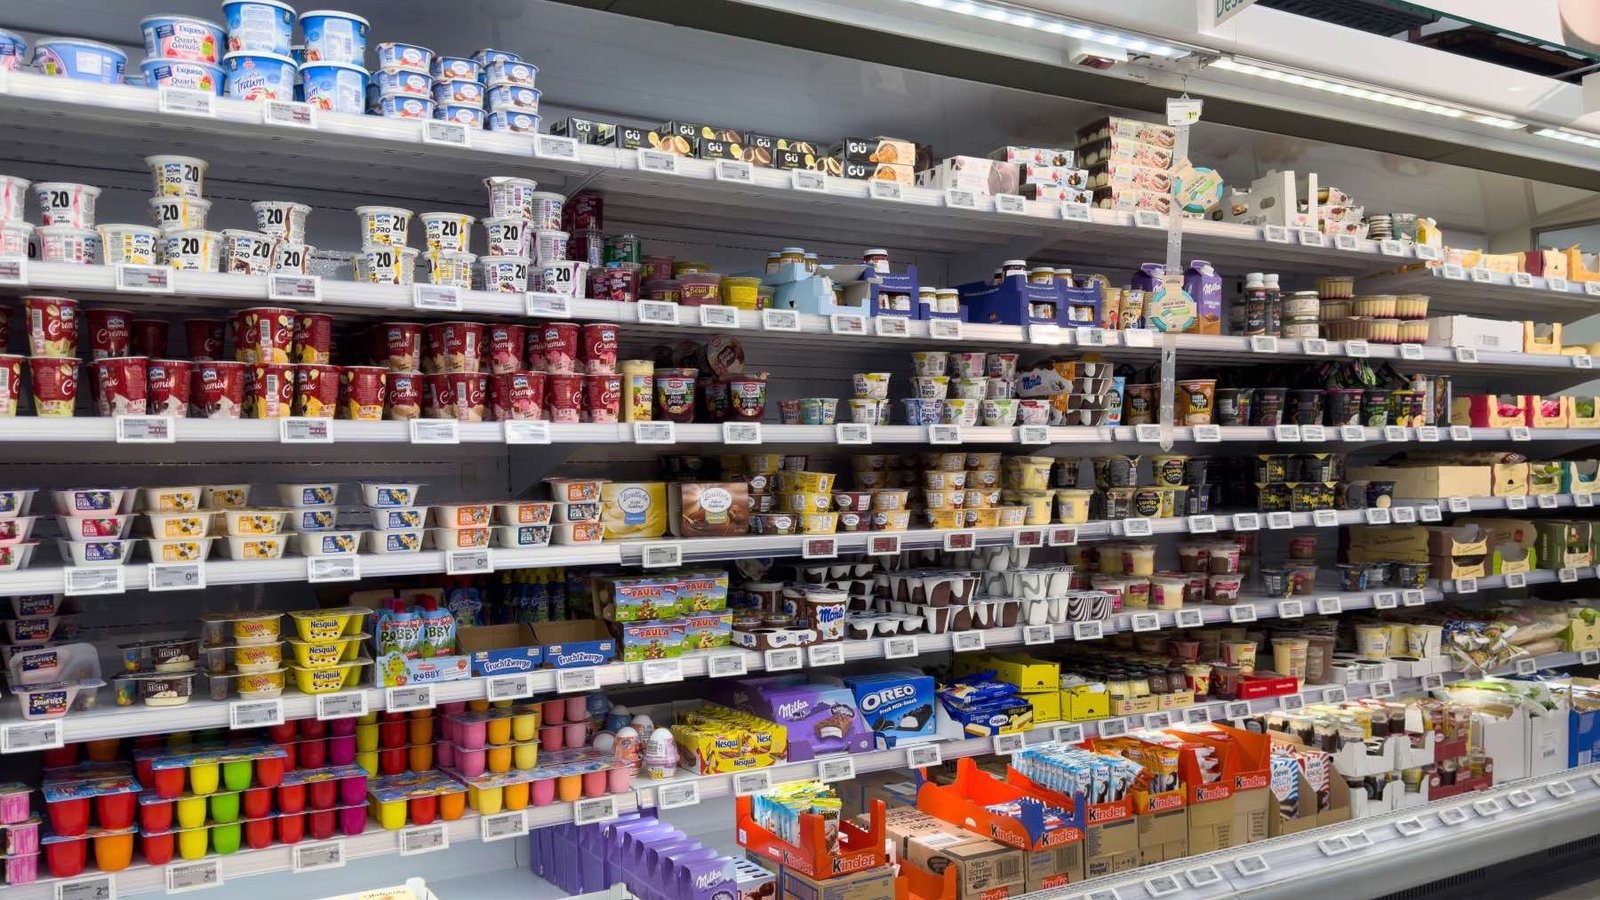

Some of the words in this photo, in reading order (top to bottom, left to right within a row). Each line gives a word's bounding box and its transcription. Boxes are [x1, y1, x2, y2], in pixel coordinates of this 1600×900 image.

[184, 164, 199, 183] 20
[50, 191, 70, 208] 20
[162, 204, 179, 221] 20
[267, 208, 283, 225] 20
[393, 215, 406, 232] 20
[442, 221, 457, 236] 20
[504, 225, 518, 241] 20
[182, 237, 199, 255] 20
[253, 241, 270, 259] 20
[284, 250, 300, 267] 20
[375, 252, 391, 268] 20
[515, 264, 527, 280] 20
[556, 267, 570, 282] 20
[631, 586, 661, 598] PAULA
[686, 581, 714, 592] PAULA
[310, 619, 339, 629] Nesquik
[691, 618, 719, 628] PAULA
[640, 628, 669, 638] PAULA
[309, 645, 336, 654] Nesquik
[485, 658, 531, 672] FruchtZwerge
[558, 652, 603, 665] FruchtZwerge
[313, 671, 340, 680] Nesquik
[861, 684, 916, 711] OREO
[778, 699, 809, 719] Milka
[733, 758, 756, 767] Nesquik
[1235, 775, 1266, 789] Kinder
[1196, 786, 1229, 801] Kinder
[1148, 794, 1182, 810] Kinder
[1088, 806, 1126, 822] Kinder
[991, 823, 1024, 848] Kinder
[1042, 828, 1078, 846] Kinder
[784, 852, 813, 876] Kinder
[832, 854, 875, 874] Kinder
